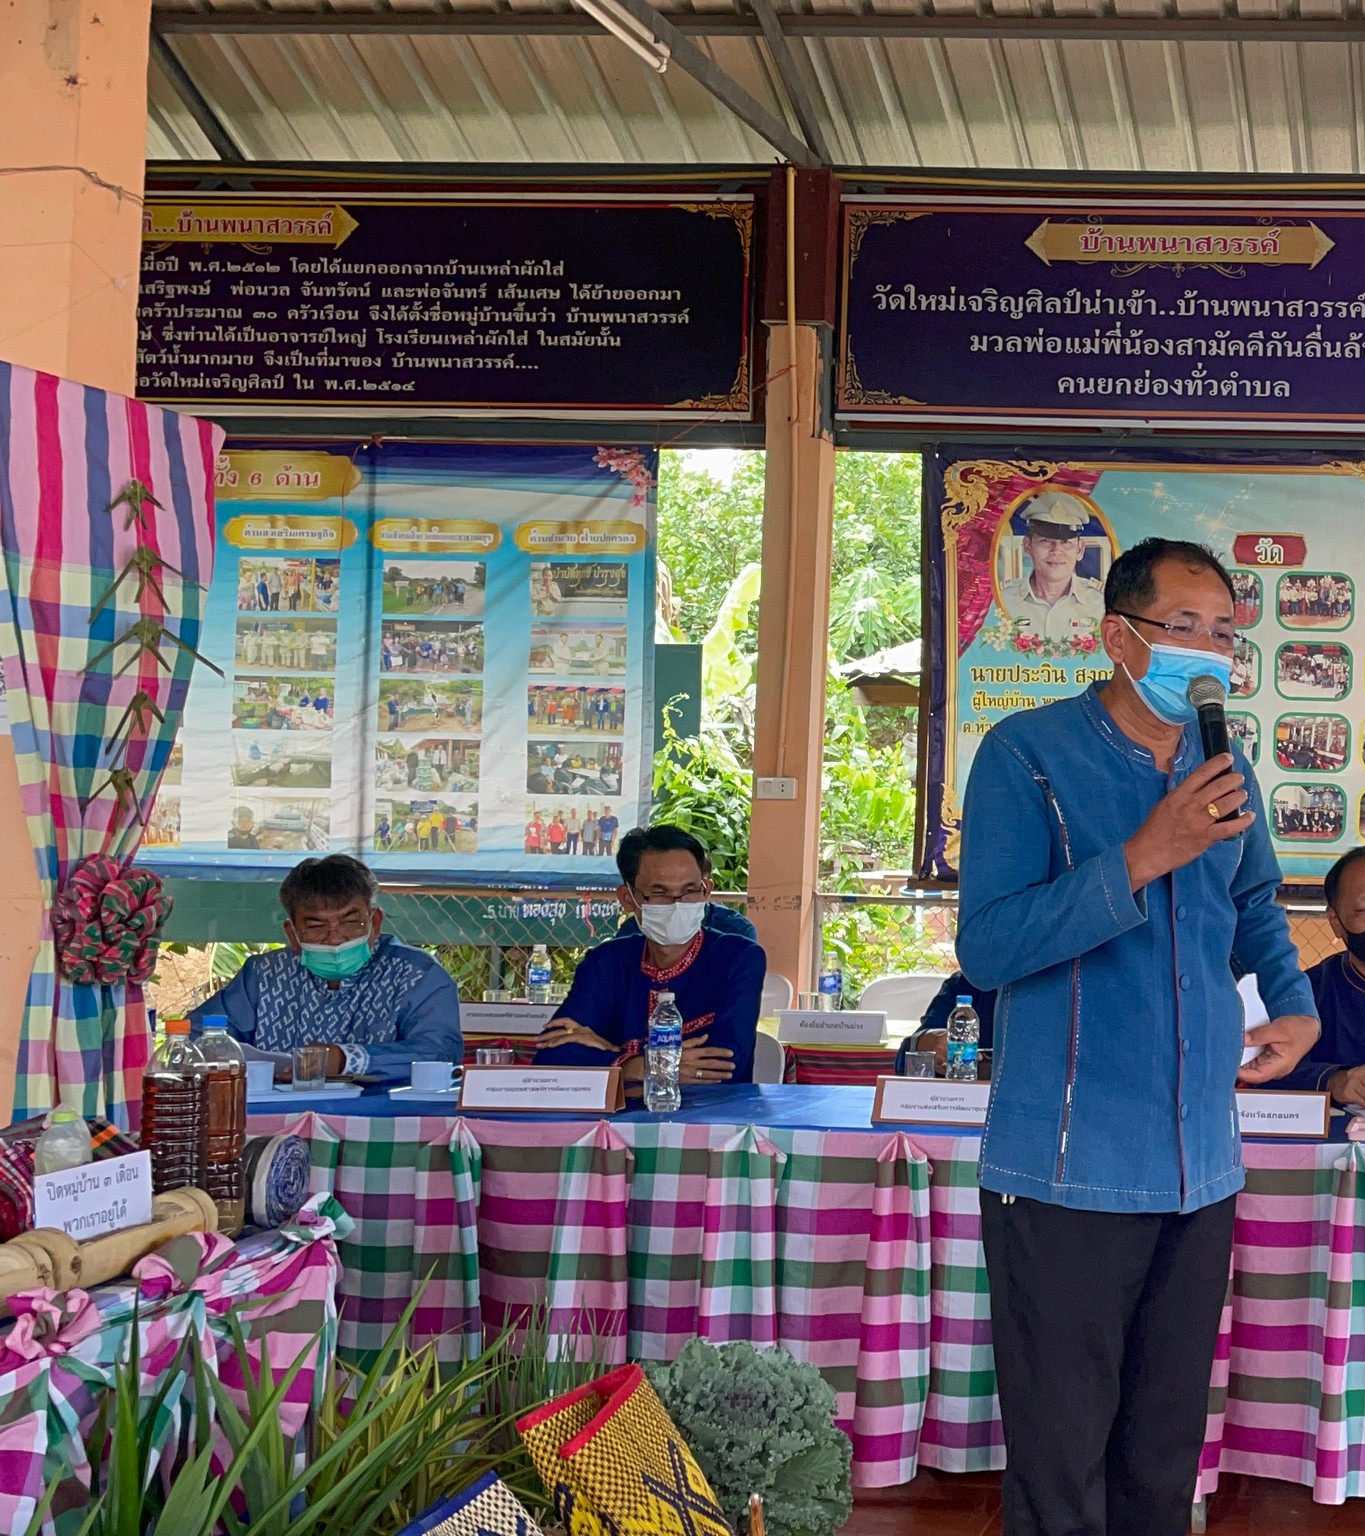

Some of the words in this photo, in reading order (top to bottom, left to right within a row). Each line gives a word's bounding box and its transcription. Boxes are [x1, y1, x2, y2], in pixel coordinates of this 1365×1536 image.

[1080, 228, 1281, 256] บ้านพนาสวรรค์
[140, 252, 178, 272] มื่อปี
[189, 260, 280, 273] พ.ศ.๒๕๑๒
[230, 281, 290, 296] พ่อนวล
[301, 281, 371, 298] จันทรัตน์
[381, 283, 487, 299] และพ่อจันทร์
[569, 283, 681, 300] ได้ย้ายออกมา
[137, 302, 242, 319] ครัวประมาณ
[253, 310, 277, 319] ๓๐
[287, 303, 359, 320] ครัวเรือน
[369, 300, 556, 326] จึงได้ตั้งชื่อหมู่บ้านขึ้นว่า
[566, 307, 690, 324] บ้านพนาสวรรค์
[161, 321, 366, 347] ซึ่งท่านได้เป็นอาจารย์ใหญ่
[378, 328, 528, 346] โรงเรียนเหล่าผักใส่
[537, 326, 621, 347] ในสมัยนั้น
[264, 346, 382, 368] จึงเป็นที่มาของ
[293, 374, 314, 391] ใน
[325, 379, 416, 391] พ.ศ.๒๕๑๔
[1057, 362, 1291, 398] คนยกย่องทั่วตำบล
[250, 472, 262, 486] 6
[275, 464, 320, 486] ด้าน
[1254, 539, 1284, 566] วัด
[970, 663, 1067, 684] นายประวิน
[972, 690, 1036, 711] ผู้ใหญ่บ้าน
[46, 1171, 100, 1202] ปิดหมู่บ้าน
[115, 1164, 139, 1184] เดือน
